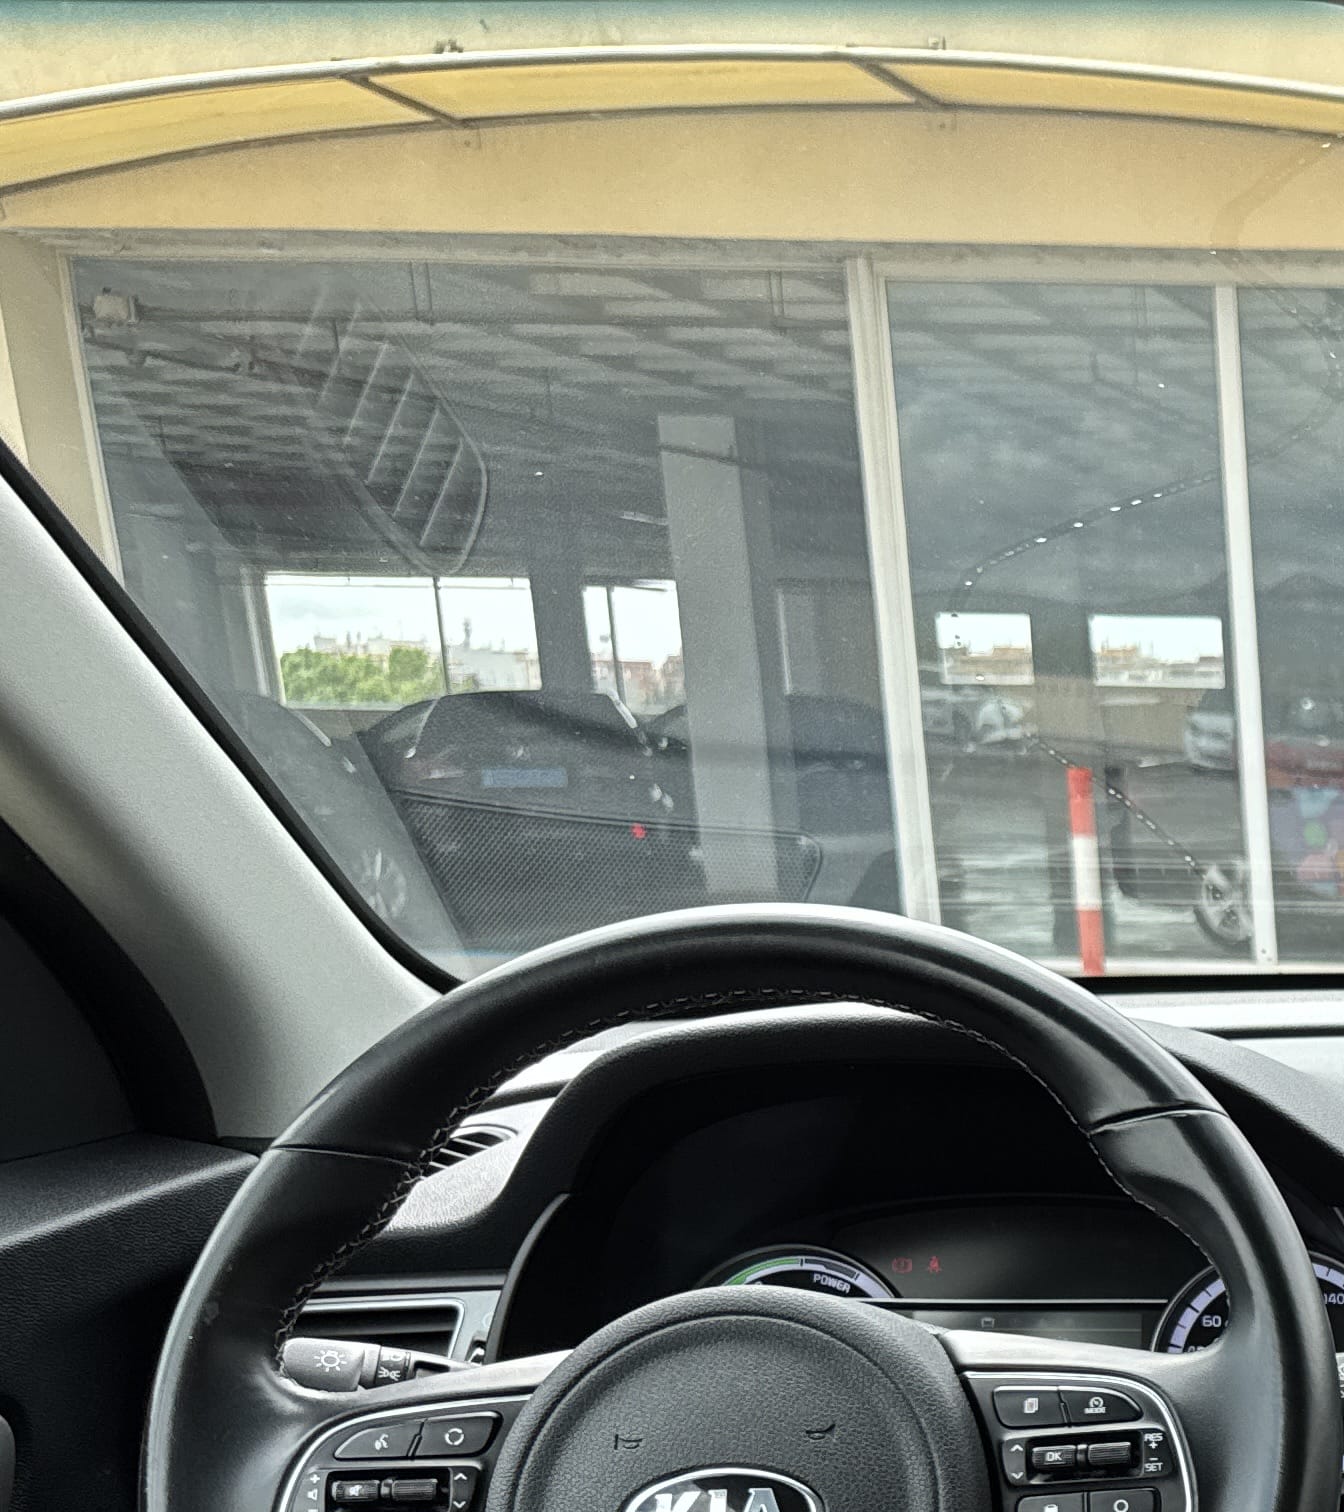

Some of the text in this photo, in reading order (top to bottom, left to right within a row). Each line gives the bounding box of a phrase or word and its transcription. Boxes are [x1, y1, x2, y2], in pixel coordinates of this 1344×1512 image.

[813, 1272, 851, 1294] POWER
[1202, 1315, 1222, 1328] 60
[1045, 1451, 1063, 1462] OK
[1144, 1462, 1163, 1472] SET
